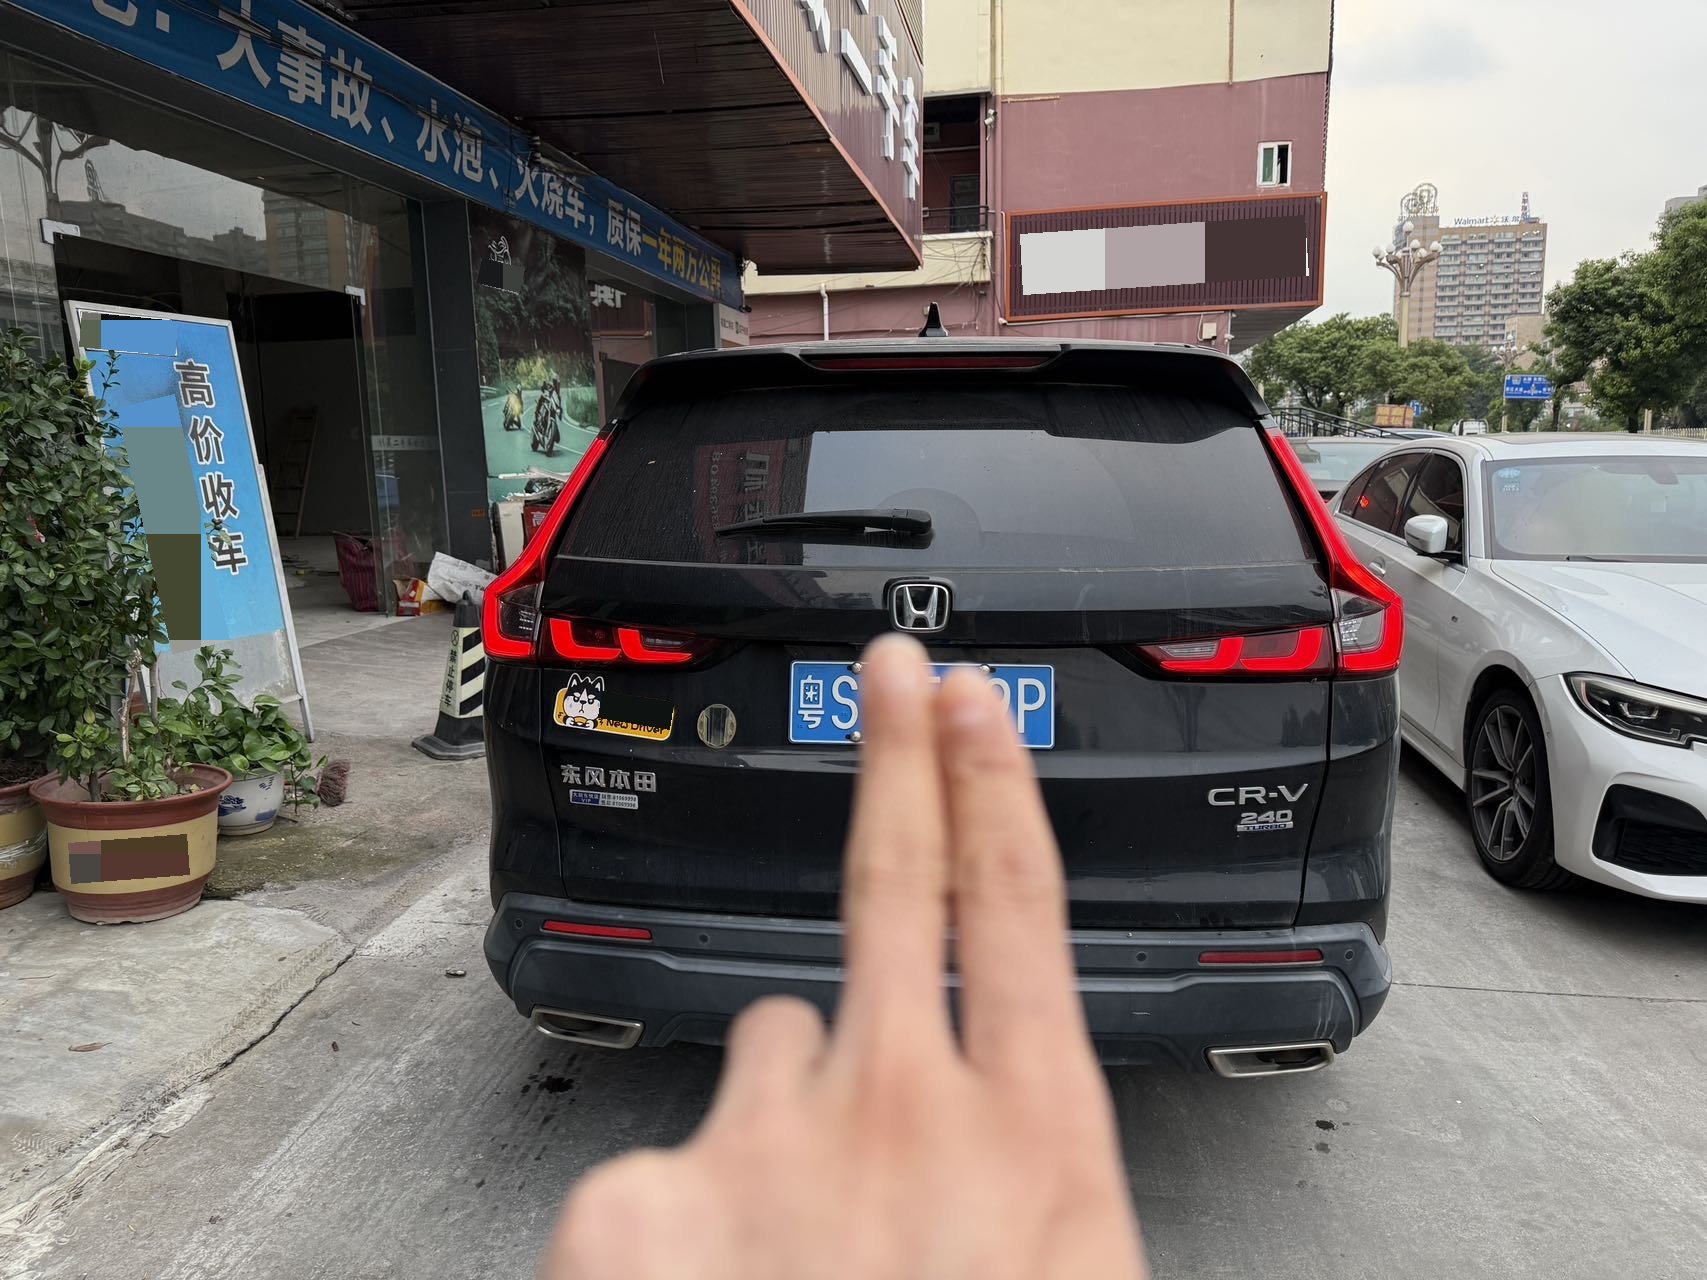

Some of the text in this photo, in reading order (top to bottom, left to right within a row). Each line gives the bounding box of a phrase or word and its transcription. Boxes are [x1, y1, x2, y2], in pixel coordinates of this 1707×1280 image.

[1453, 216, 1490, 226] Walmart
[173, 358, 249, 576] 高价收车
[560, 764, 657, 793] 东风本田
[1207, 783, 1309, 807] CR-V
[1240, 809, 1293, 825] 240
[1245, 823, 1288, 831] TURBO
